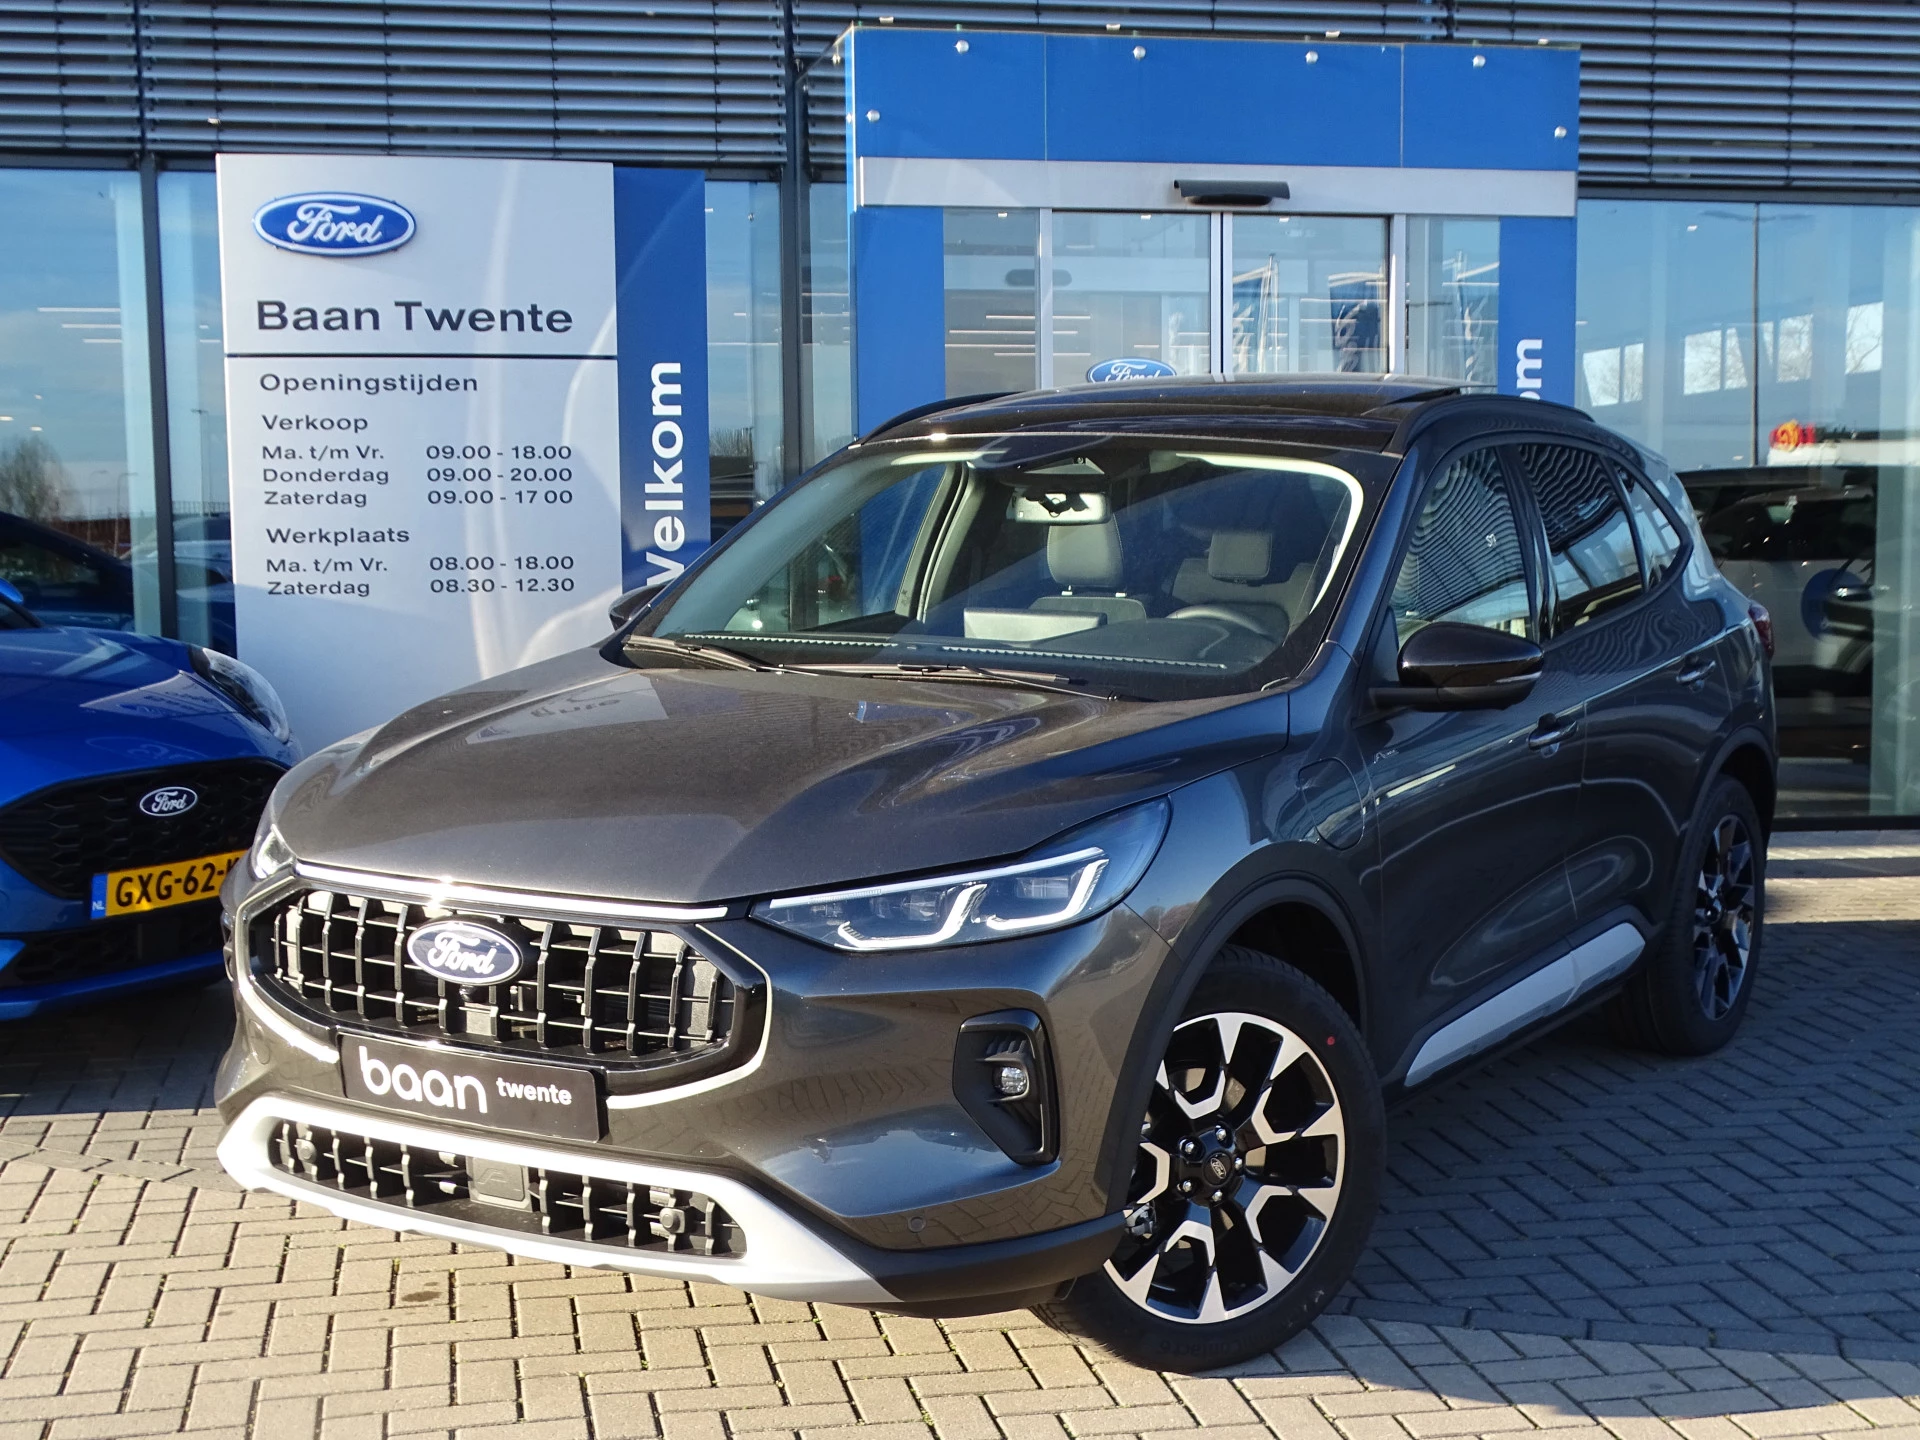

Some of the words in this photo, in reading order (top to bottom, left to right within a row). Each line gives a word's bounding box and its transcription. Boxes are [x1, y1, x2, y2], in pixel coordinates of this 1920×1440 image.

[286, 201, 383, 244] Ford
[257, 300, 380, 332] Baan
[394, 301, 573, 333] Twente
[1516, 338, 1543, 401] m
[259, 373, 478, 396] Openingstijden
[262, 414, 369, 434] Verkoop
[262, 445, 303, 460] Ma.
[309, 445, 349, 462] t/m
[355, 445, 384, 460] Vr.
[425, 444, 491, 460] 09.00
[511, 444, 572, 460] 18.00
[263, 467, 389, 486] Donderdag
[426, 467, 492, 482] 09.00
[510, 467, 573, 482] 20.00
[264, 490, 367, 508] Zaterdag
[427, 489, 494, 505] 09.00
[266, 527, 410, 547] Werkplaats
[266, 558, 307, 573] Ma.
[313, 558, 353, 575] t/m
[359, 557, 388, 572] Vr.
[429, 555, 495, 571] 08.00
[514, 555, 574, 571] 18.00
[267, 580, 370, 598] Zaterdag
[430, 577, 496, 594] 08.30
[515, 577, 575, 594] 12.30
[92, 901, 105, 911] NL
[427, 931, 498, 975] Ford
[358, 1045, 488, 1114] baan
[495, 1076, 573, 1106] twente
